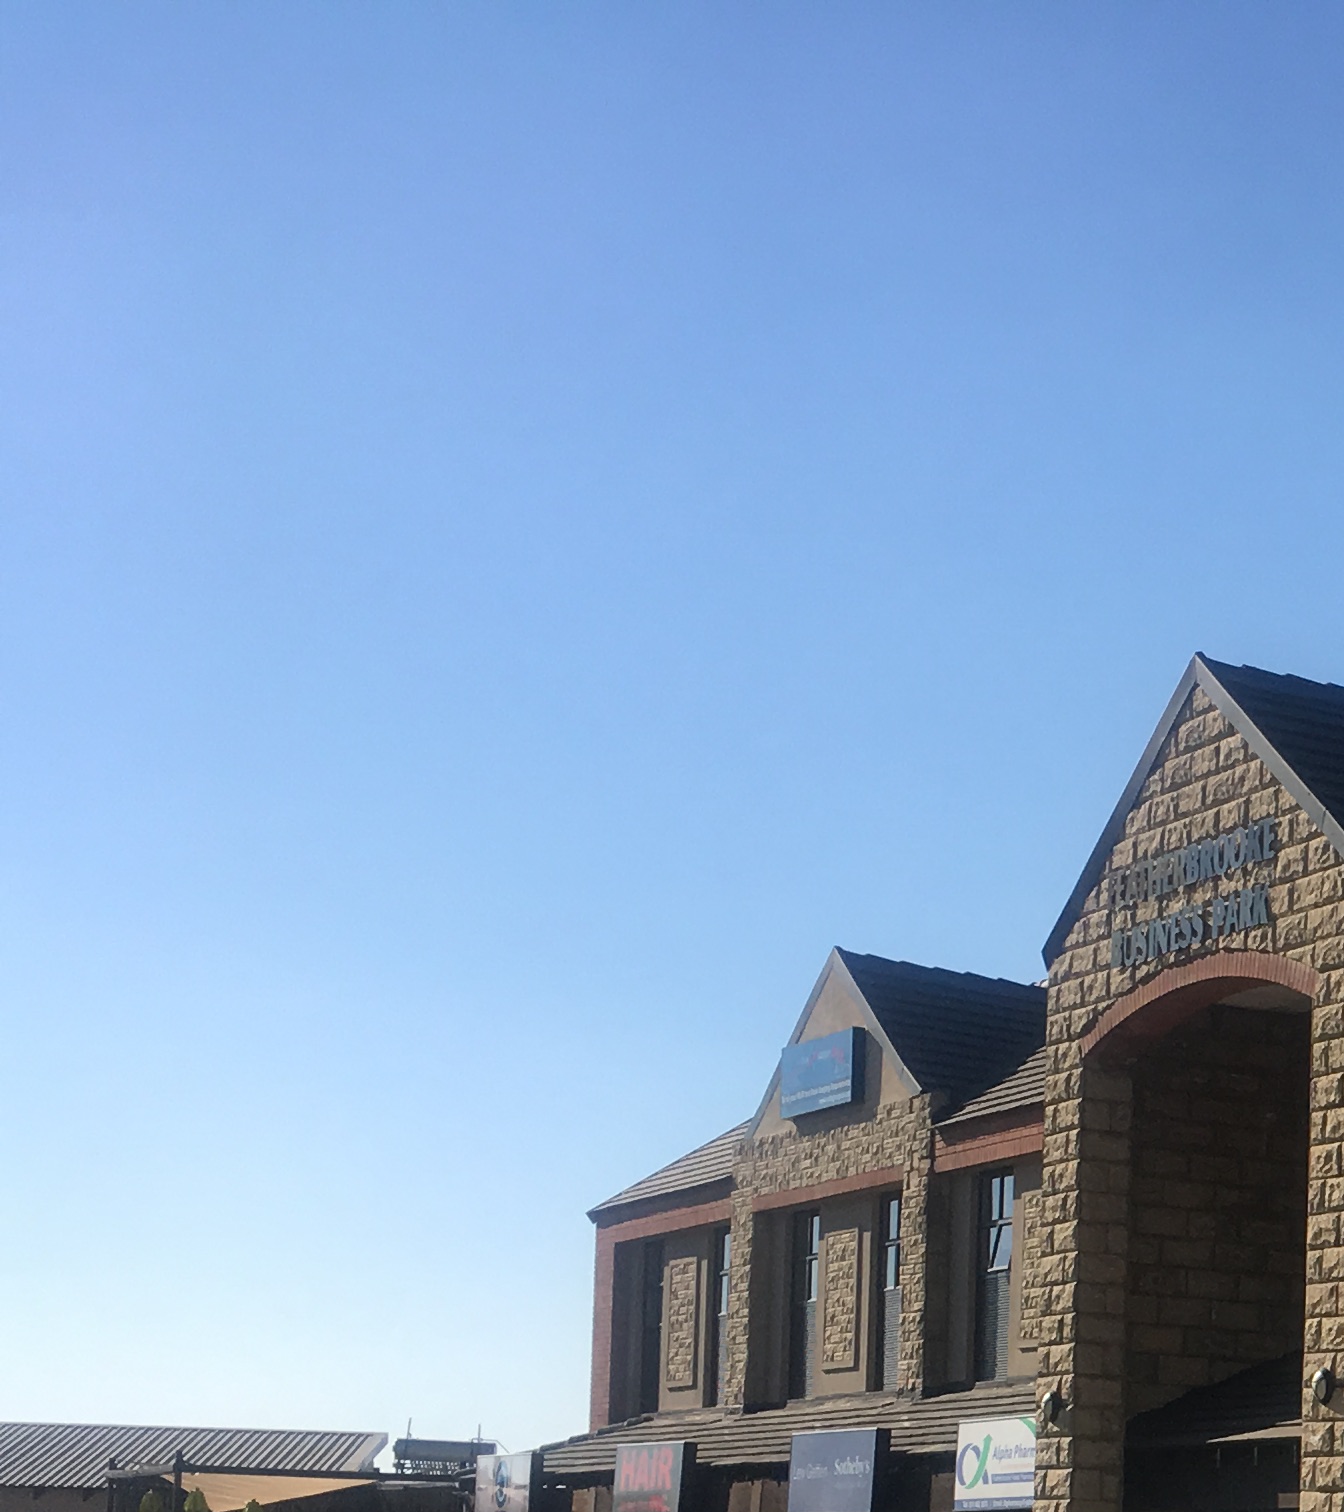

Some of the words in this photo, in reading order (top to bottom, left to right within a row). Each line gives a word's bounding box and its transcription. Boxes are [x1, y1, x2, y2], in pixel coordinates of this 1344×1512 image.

[1107, 817, 1277, 907] FEATHERBROOKE
[1110, 904, 1204, 968] BUSINESS
[1211, 884, 1270, 939] PARK
[619, 1447, 673, 1491] HAIR
